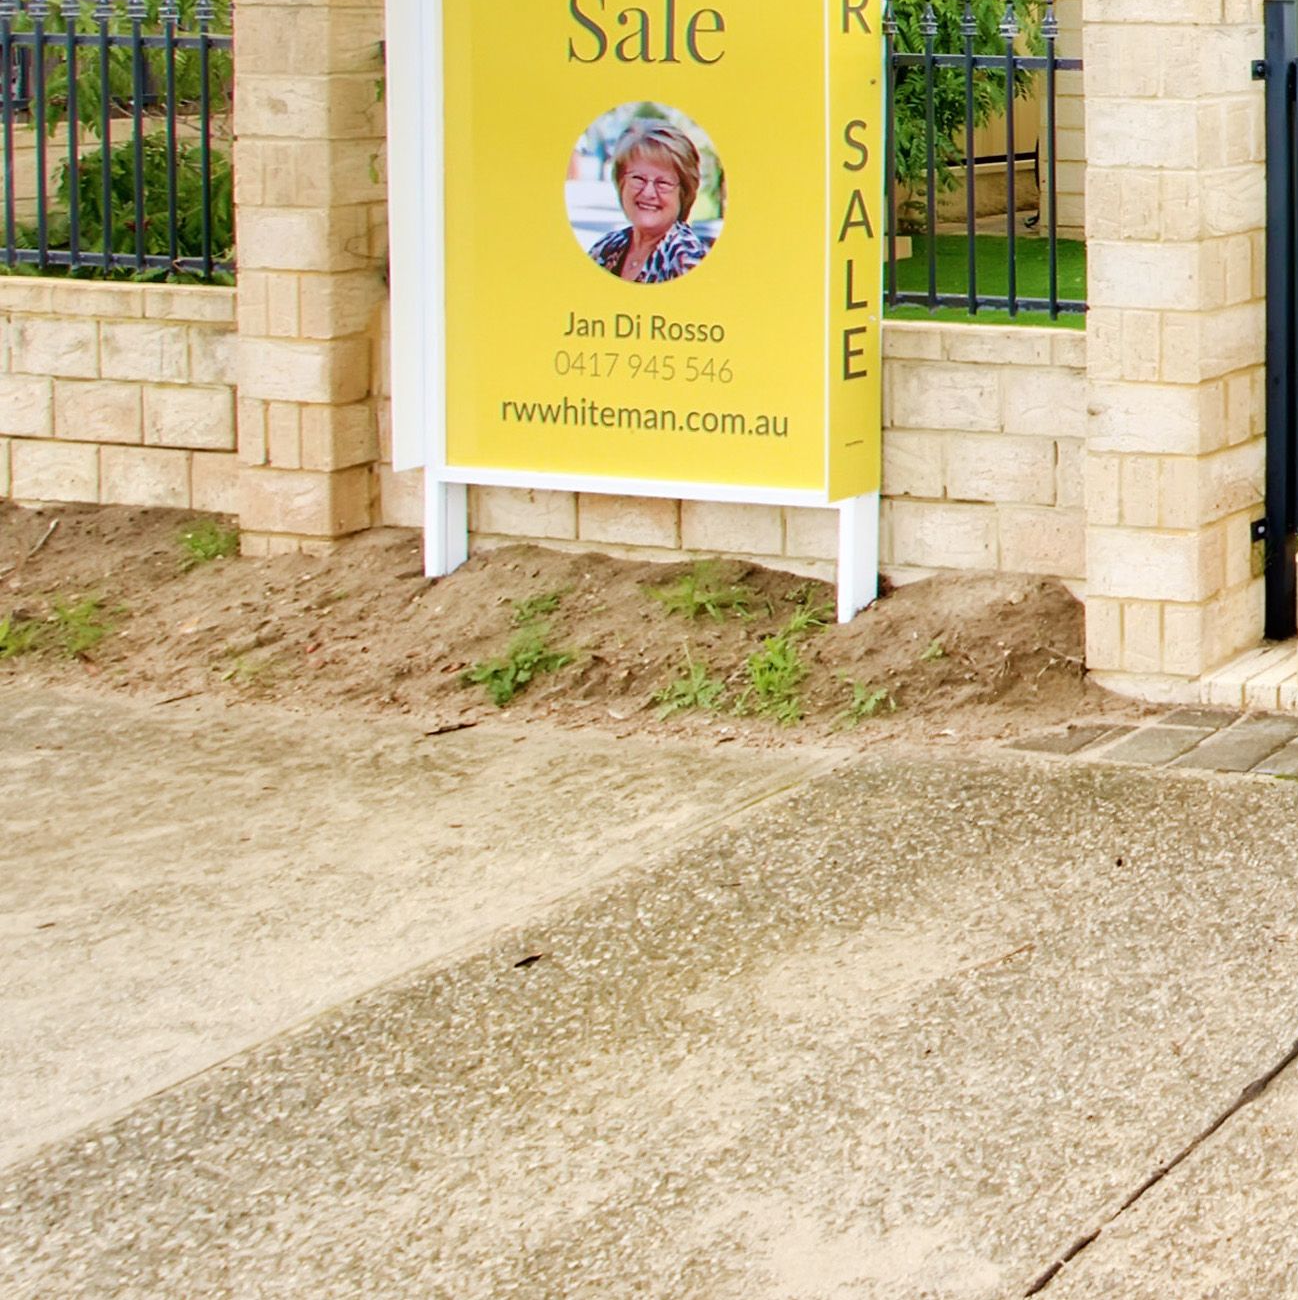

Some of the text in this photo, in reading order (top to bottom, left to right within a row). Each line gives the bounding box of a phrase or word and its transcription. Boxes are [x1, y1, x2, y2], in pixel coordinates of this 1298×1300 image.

[838, 120, 874, 381] SALE
[563, 311, 726, 343] Jan Di Rosso
[554, 350, 734, 384] 0417 945 546
[501, 396, 789, 438] rwwhiteman.com.au
